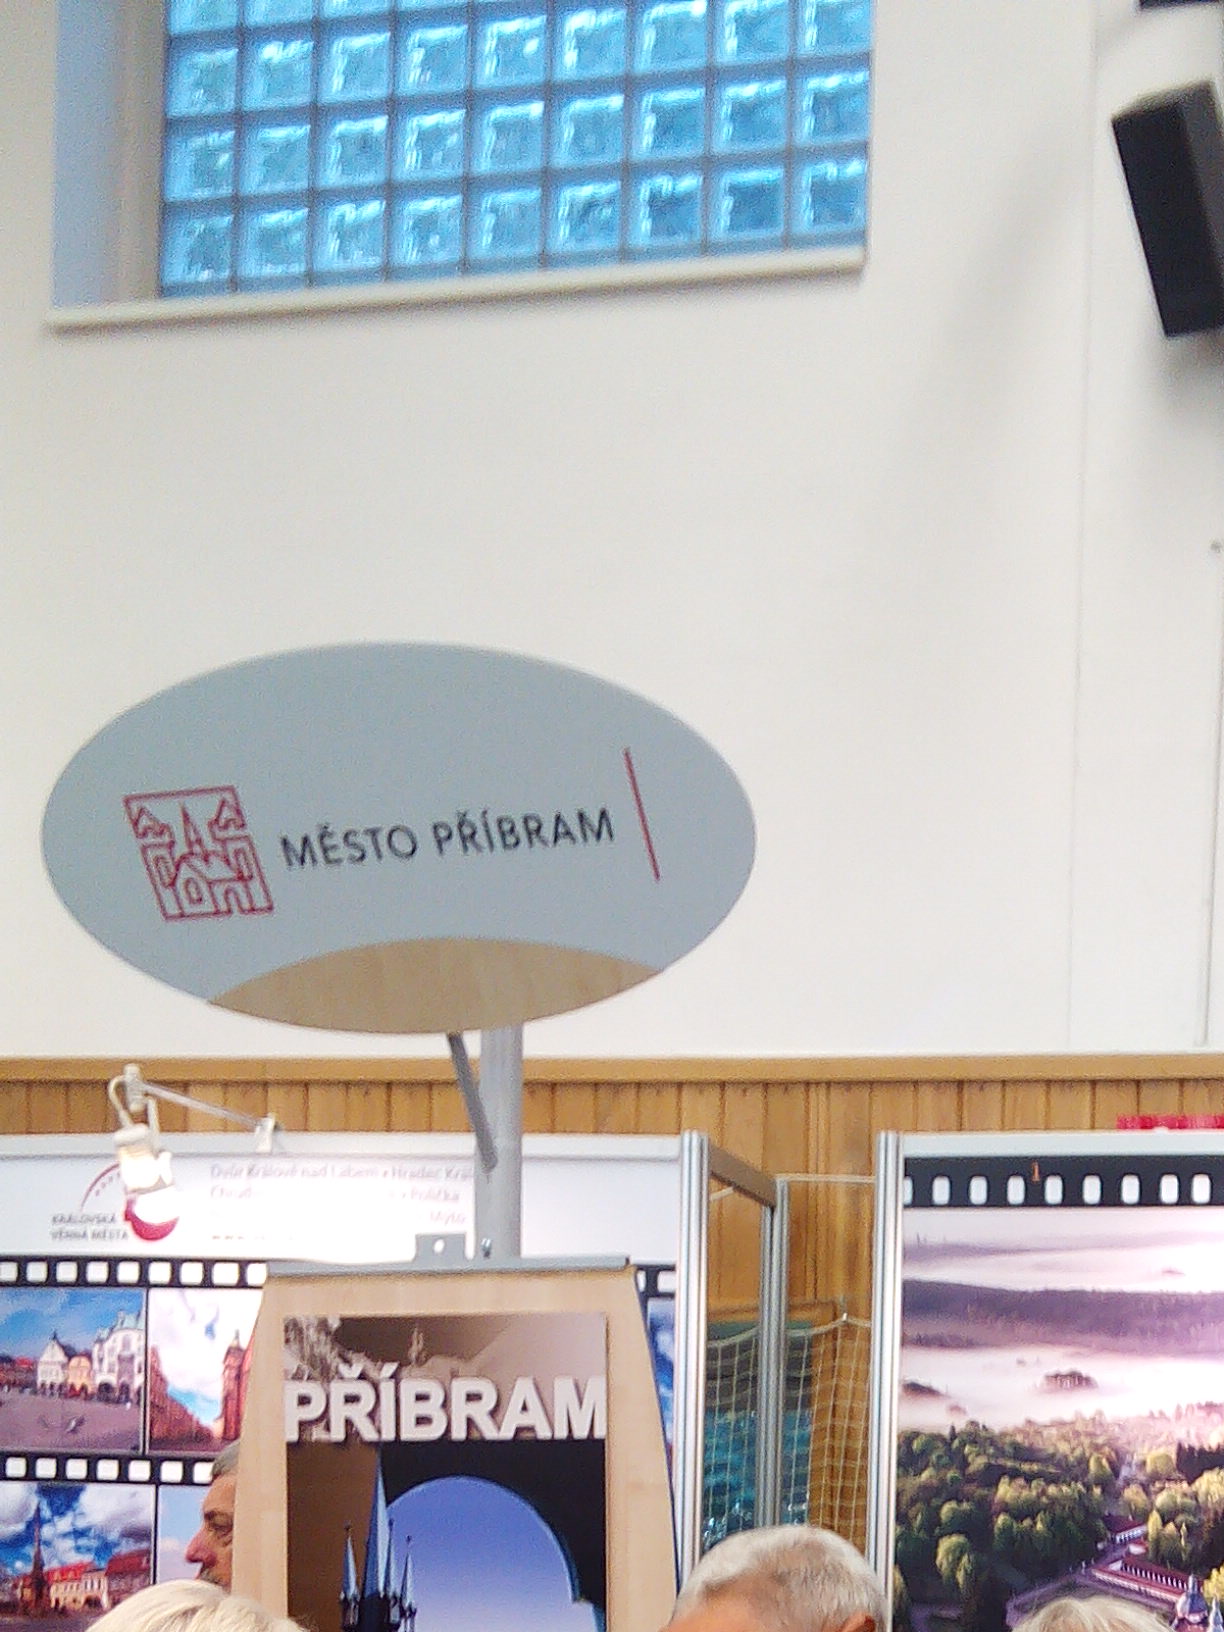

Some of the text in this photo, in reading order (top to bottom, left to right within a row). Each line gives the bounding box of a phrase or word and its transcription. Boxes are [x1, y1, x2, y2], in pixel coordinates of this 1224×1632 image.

[279, 806, 615, 868] MĚSTO PŘÍBRAM
[285, 1362, 607, 1442] PŘÍBRAM
